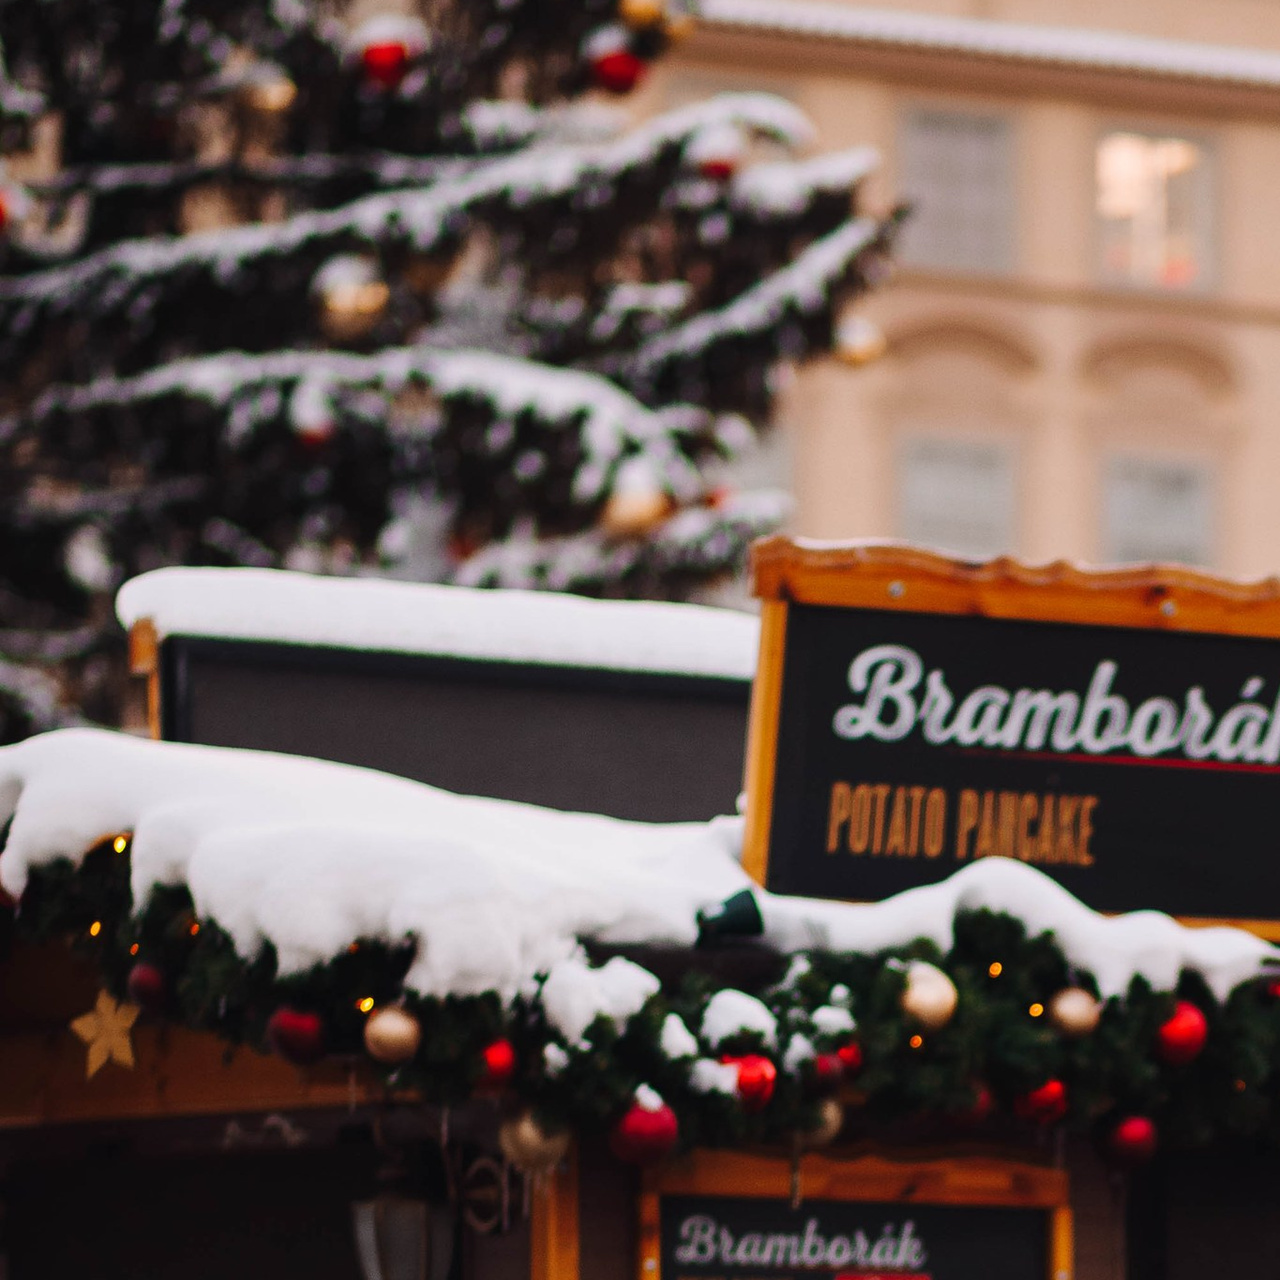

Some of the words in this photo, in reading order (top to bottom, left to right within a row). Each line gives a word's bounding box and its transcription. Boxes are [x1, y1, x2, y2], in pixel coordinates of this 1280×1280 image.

[826, 781, 947, 859] POTATO
[955, 787, 1099, 866] PANCAKE
[676, 1216, 927, 1268] Bramborák
